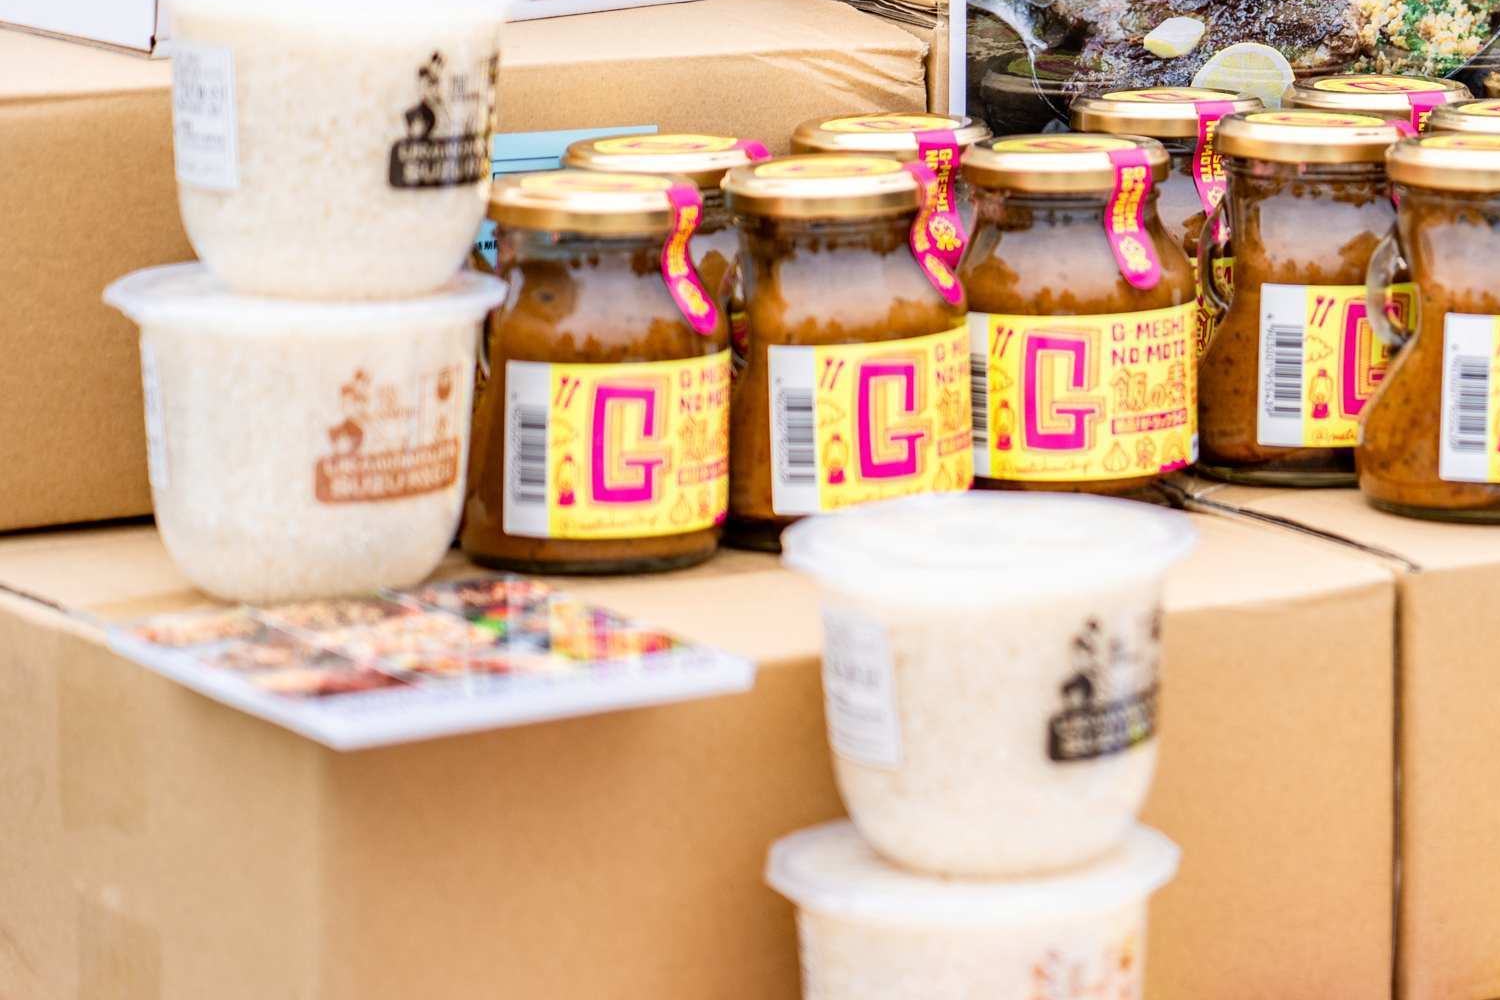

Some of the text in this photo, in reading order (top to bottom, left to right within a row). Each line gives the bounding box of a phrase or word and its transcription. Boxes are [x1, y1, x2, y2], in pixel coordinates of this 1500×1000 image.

[588, 375, 672, 506] G
[852, 349, 933, 483] G
[1019, 326, 1105, 453] G
